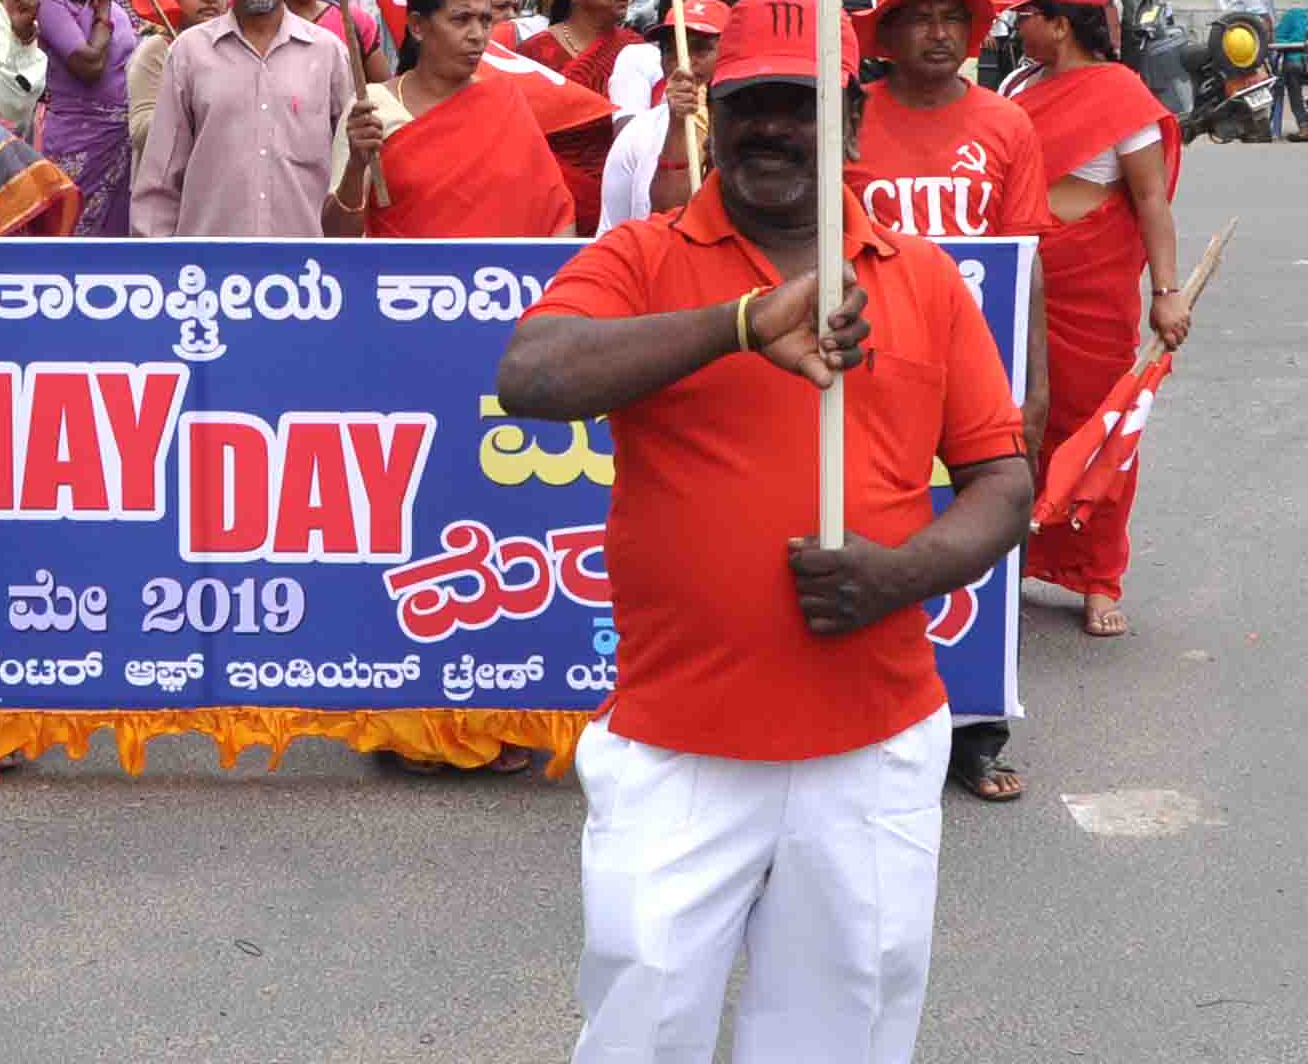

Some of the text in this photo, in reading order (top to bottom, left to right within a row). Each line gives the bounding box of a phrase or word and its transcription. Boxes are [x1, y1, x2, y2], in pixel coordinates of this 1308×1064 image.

[863, 176, 992, 236] CITU
[179, 411, 437, 563] DAY
[142, 576, 306, 634] 2019
